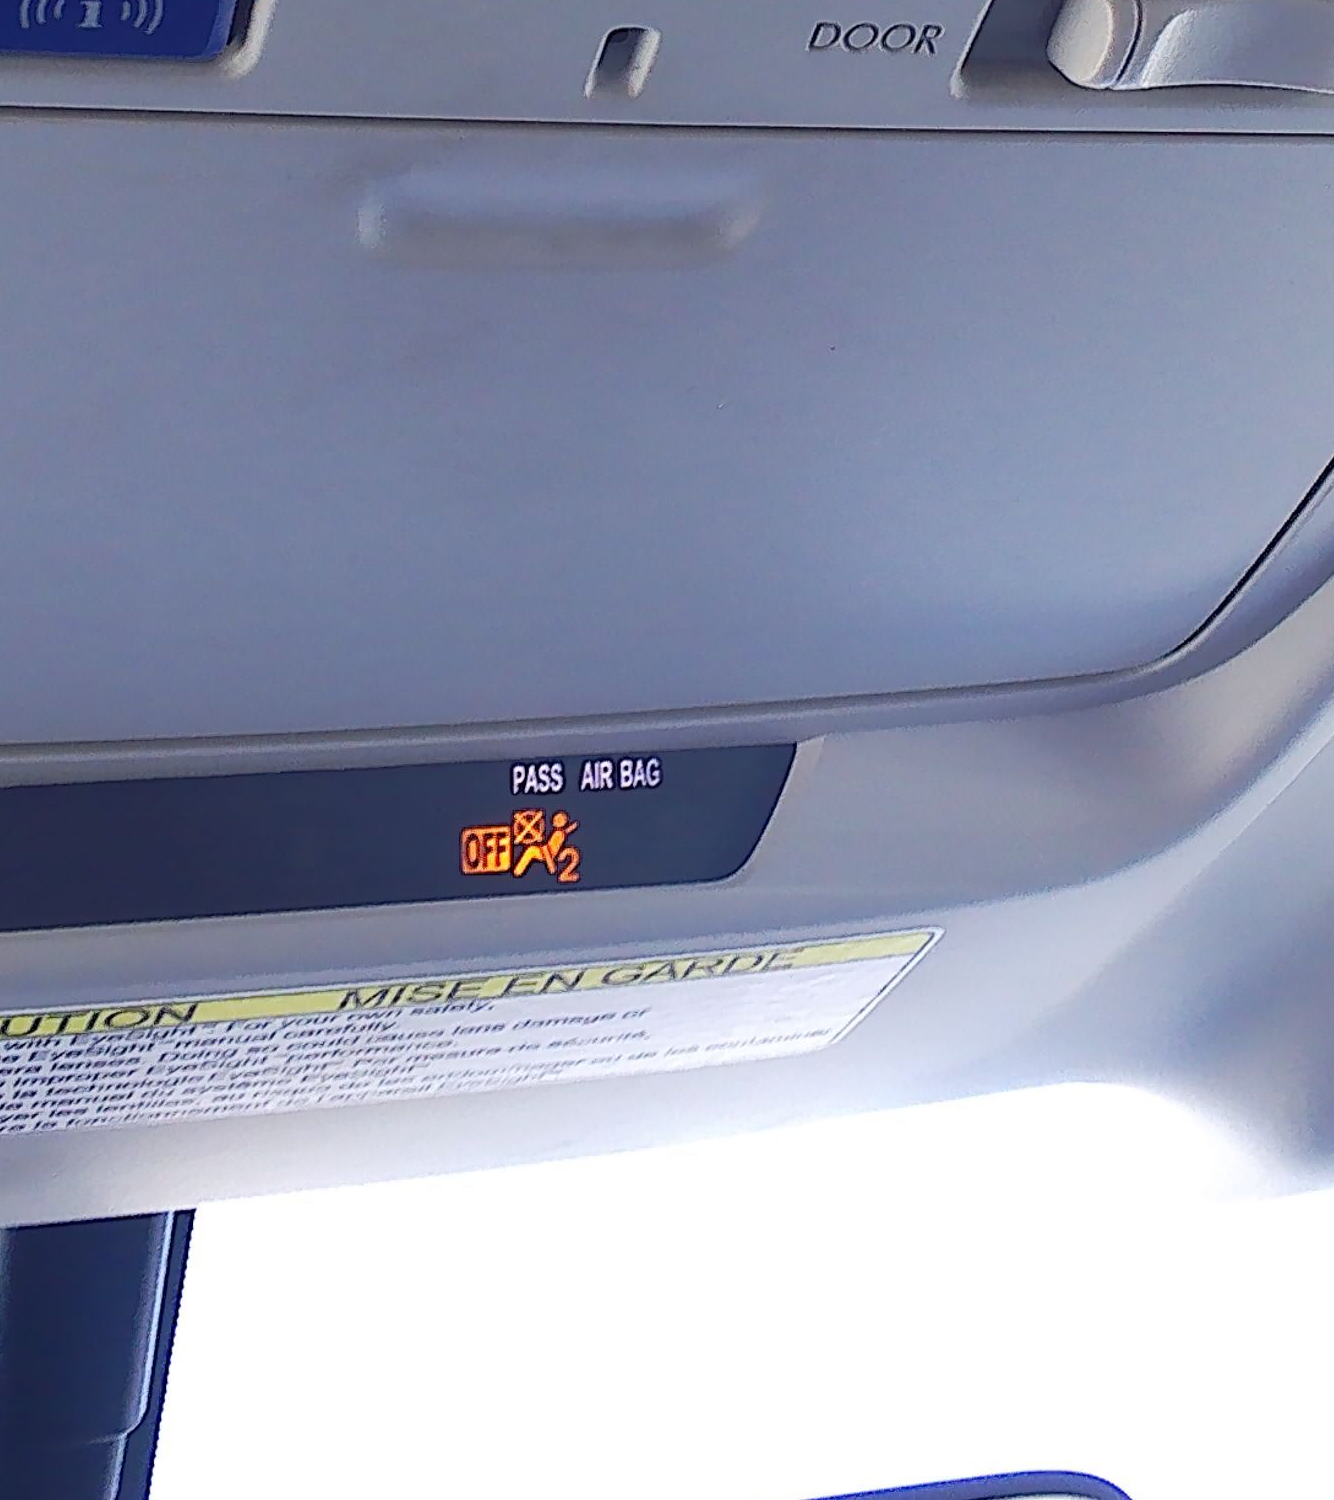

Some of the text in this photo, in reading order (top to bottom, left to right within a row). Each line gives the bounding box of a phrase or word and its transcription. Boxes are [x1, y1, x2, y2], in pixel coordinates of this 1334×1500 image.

[807, 20, 945, 56] DOOR
[512, 757, 661, 794] PASS AIR BAG
[466, 832, 509, 870] OFF
[336, 952, 795, 1011] MISE EN GARDE
[4, 1036, 61, 1051] with
[226, 1020, 269, 1032] For
[278, 1013, 338, 1030] your
[347, 1010, 403, 1020] own
[174, 1031, 276, 1049] manual
[158, 1049, 239, 1062] Doing
[246, 1045, 279, 1054] so
[286, 1036, 361, 1050] could
[13, 1069, 138, 1088] improper
